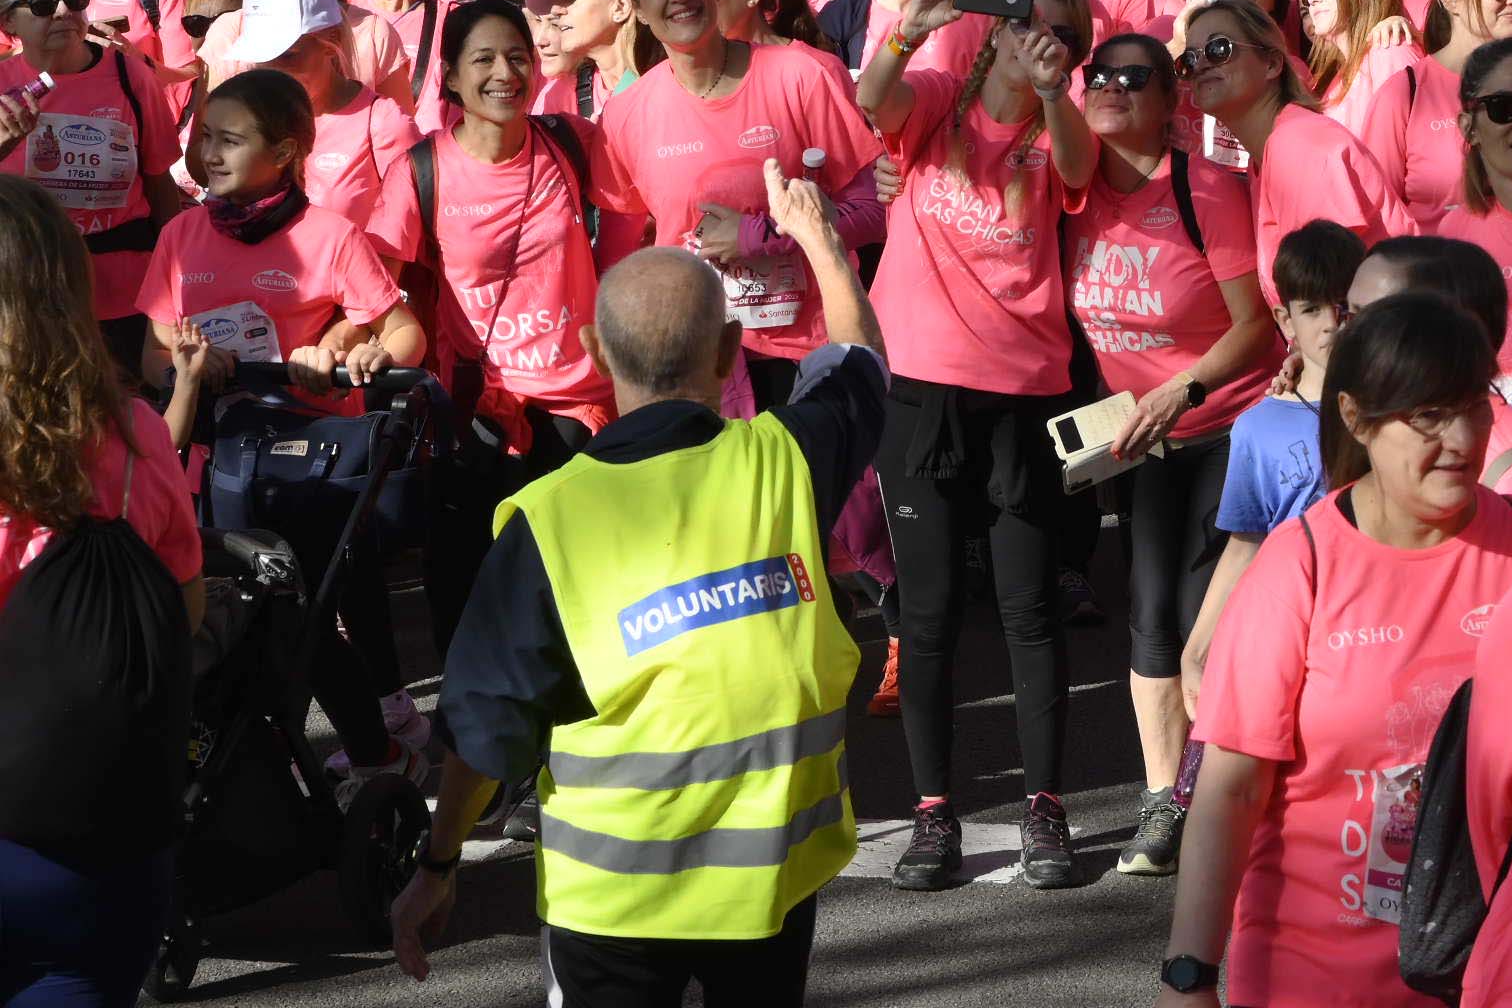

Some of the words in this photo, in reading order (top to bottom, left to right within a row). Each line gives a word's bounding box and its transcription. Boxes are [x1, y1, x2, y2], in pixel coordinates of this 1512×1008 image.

[1430, 119, 1456, 132] OYS
[64, 152, 100, 166] 016
[656, 141, 704, 159] OYSHO
[930, 178, 1000, 223] GANAN
[923, 197, 955, 225] LAS
[957, 215, 1036, 245] CHICAS
[460, 284, 497, 311] TU
[623, 571, 792, 642] VOLUNTARIS
[1328, 624, 1404, 650] OYSHO
